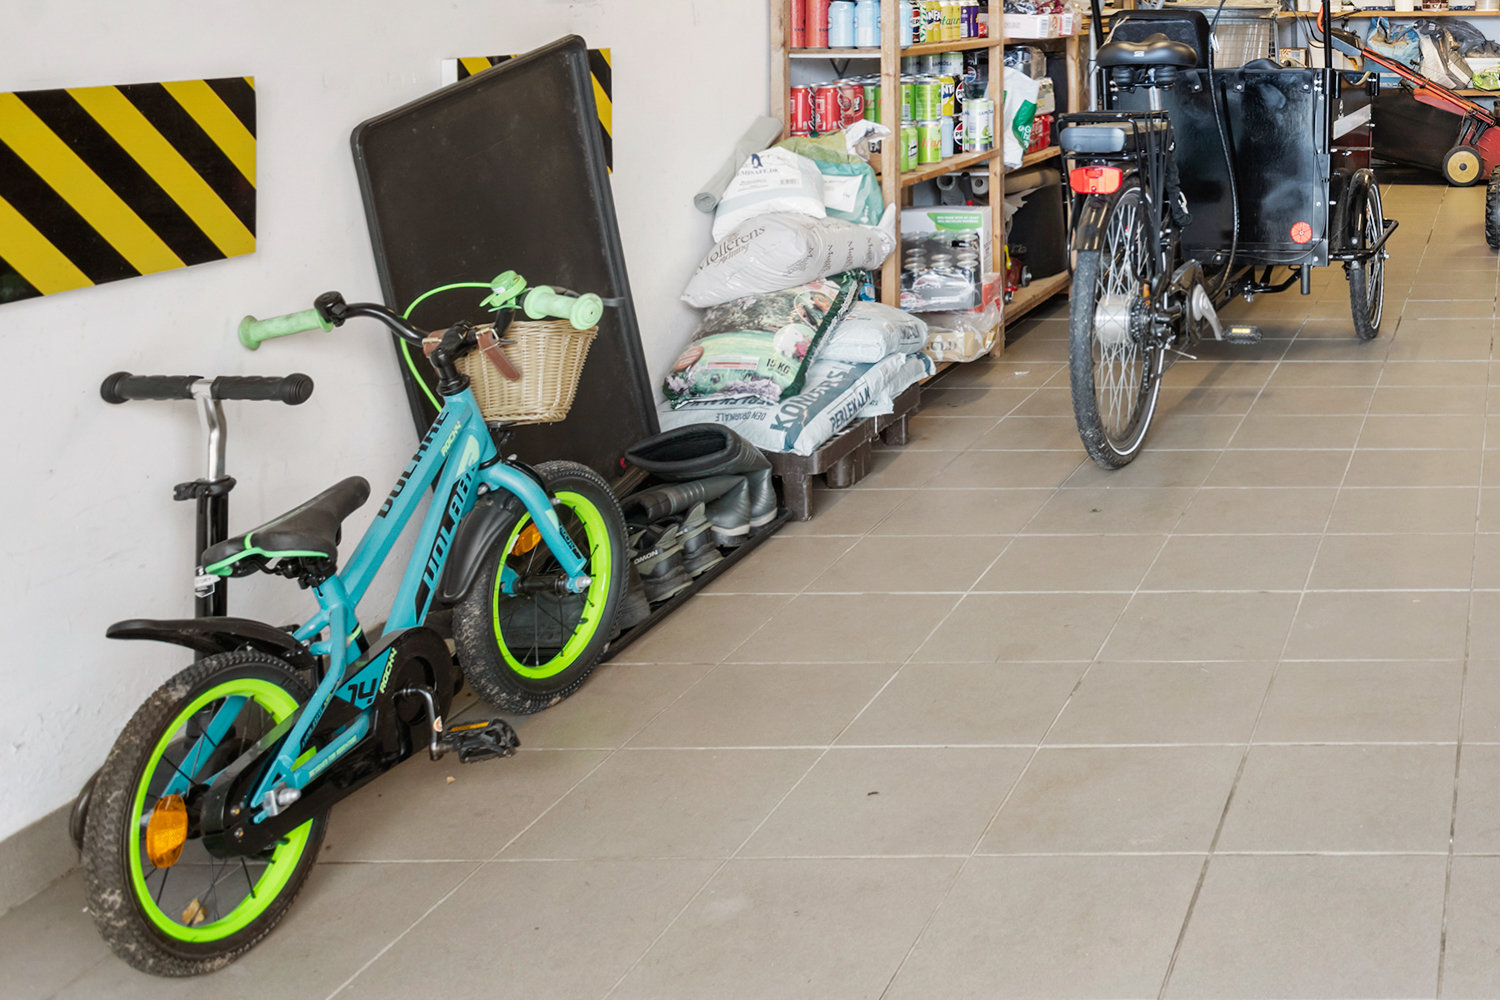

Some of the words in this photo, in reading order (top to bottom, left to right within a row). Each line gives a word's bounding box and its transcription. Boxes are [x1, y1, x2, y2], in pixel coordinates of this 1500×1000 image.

[778, 361, 791, 375] KG
[750, 411, 767, 422] DEN
[633, 549, 659, 565] OMON
[379, 647, 398, 694] ROCKY
